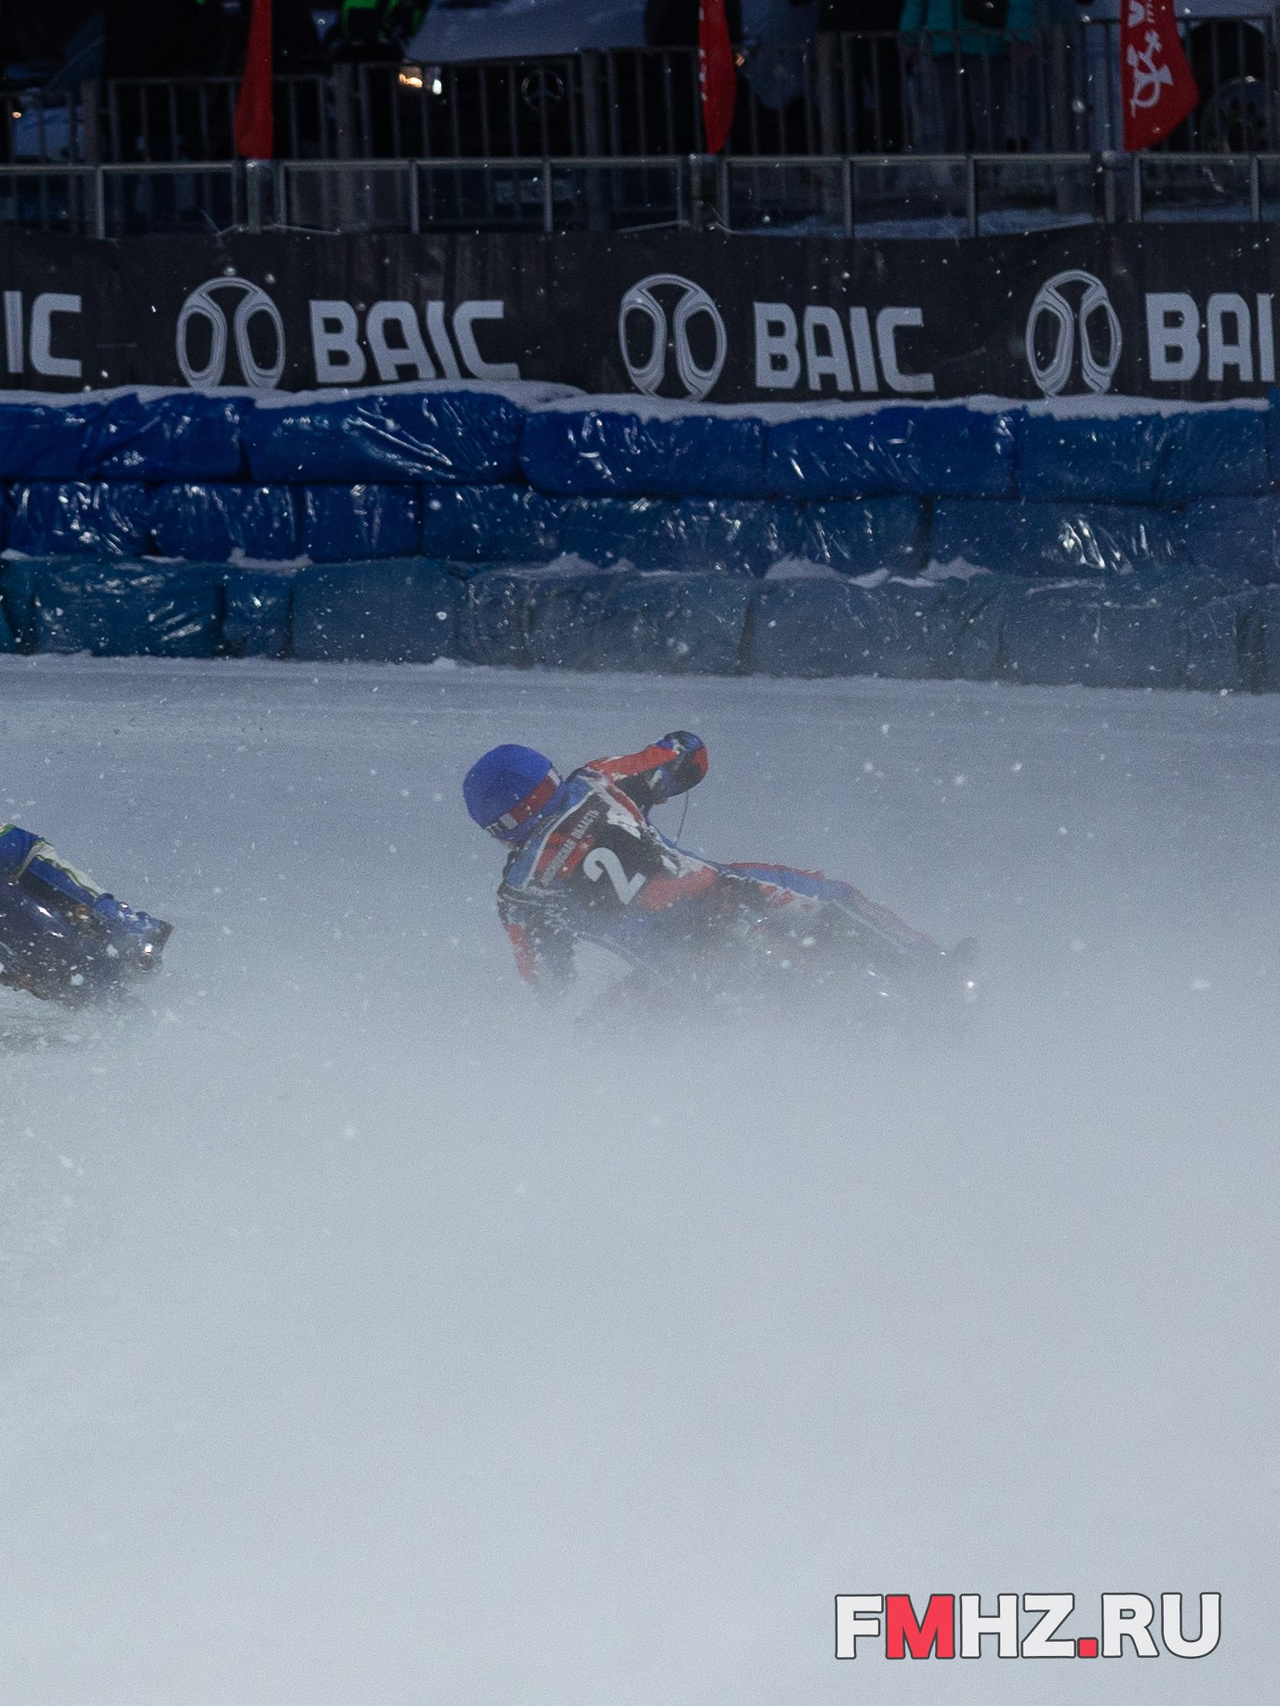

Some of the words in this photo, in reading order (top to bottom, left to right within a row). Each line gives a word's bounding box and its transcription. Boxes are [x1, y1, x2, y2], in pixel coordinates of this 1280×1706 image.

[310, 301, 520, 383] BAIC
[754, 303, 933, 391] BAIC
[1146, 293, 1274, 381] BAI
[571, 809, 600, 840] ОБЛАСТЬ
[583, 847, 646, 904] 2
